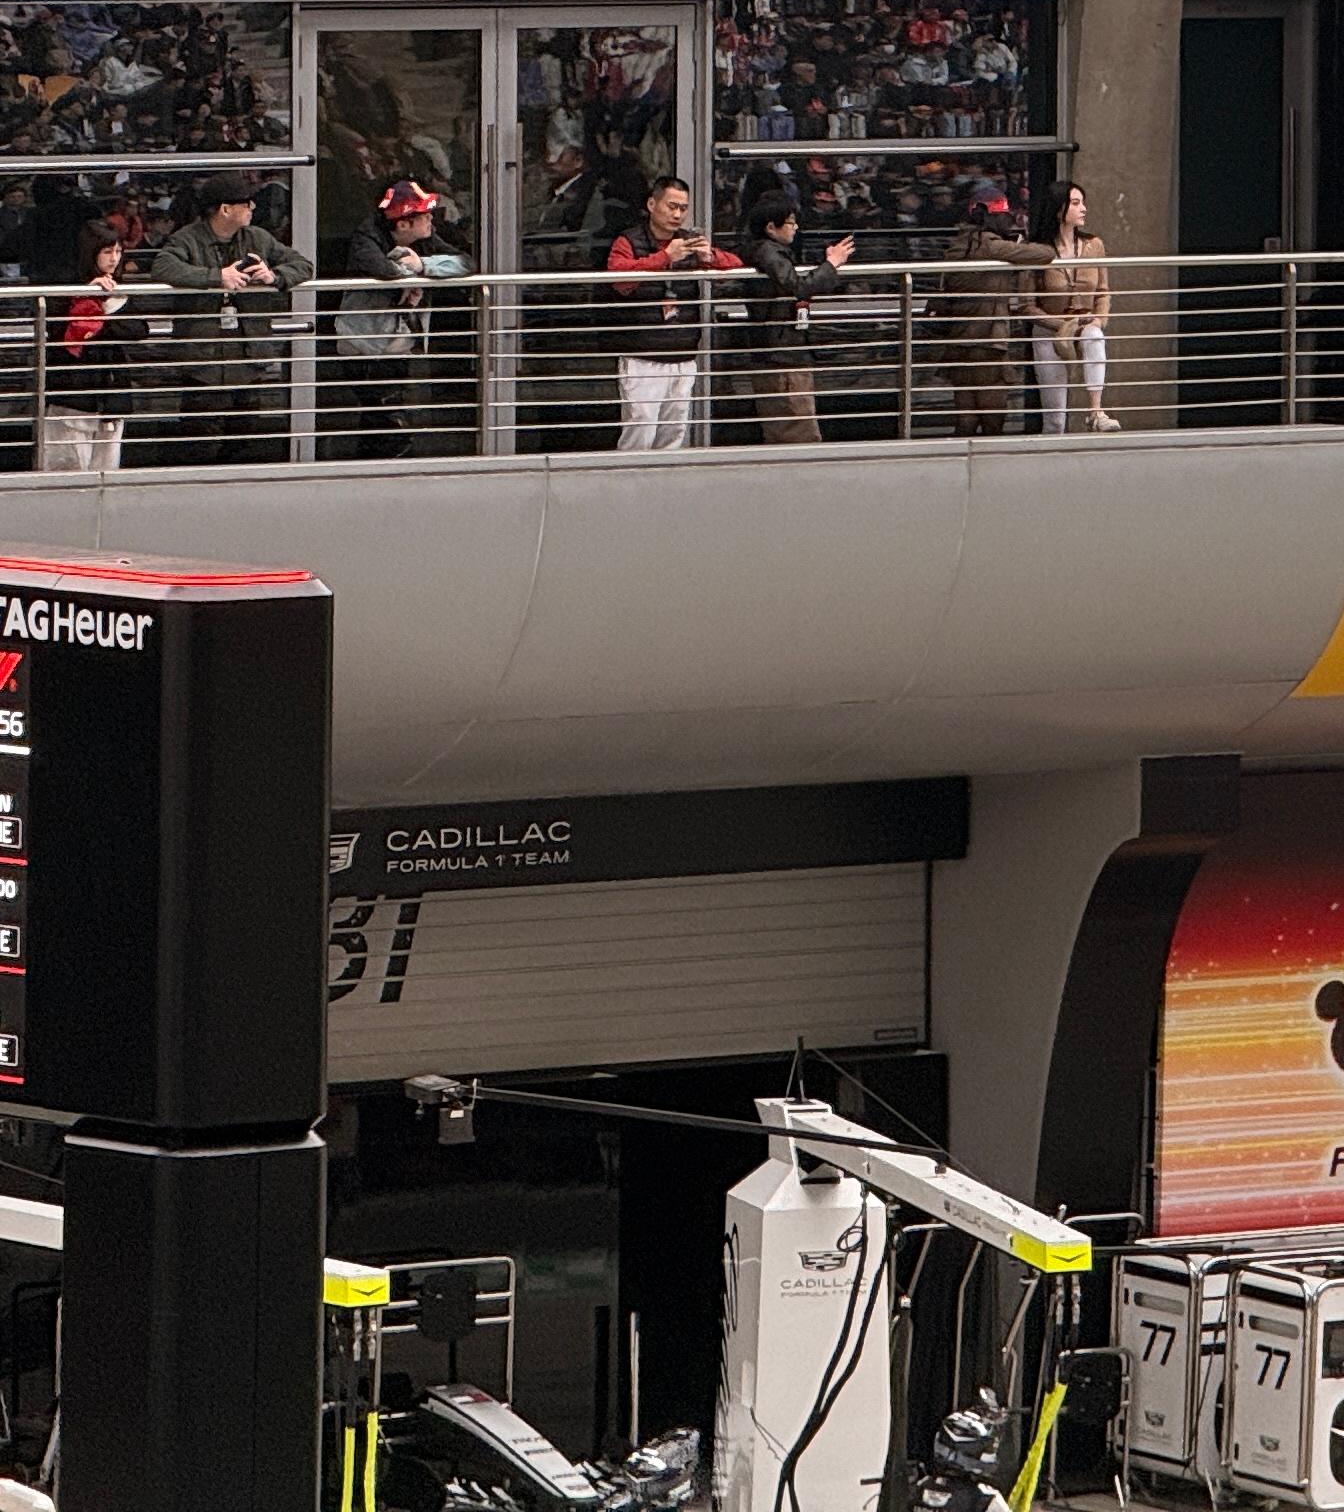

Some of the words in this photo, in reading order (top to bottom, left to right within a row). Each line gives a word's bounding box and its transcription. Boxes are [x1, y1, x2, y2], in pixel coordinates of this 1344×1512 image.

[386, 821, 572, 852] CADILLAC
[386, 855, 488, 873] FORMULA
[511, 850, 570, 865] TEAM
[1140, 1320, 1177, 1366] 77
[1255, 1344, 1291, 1390] 77
